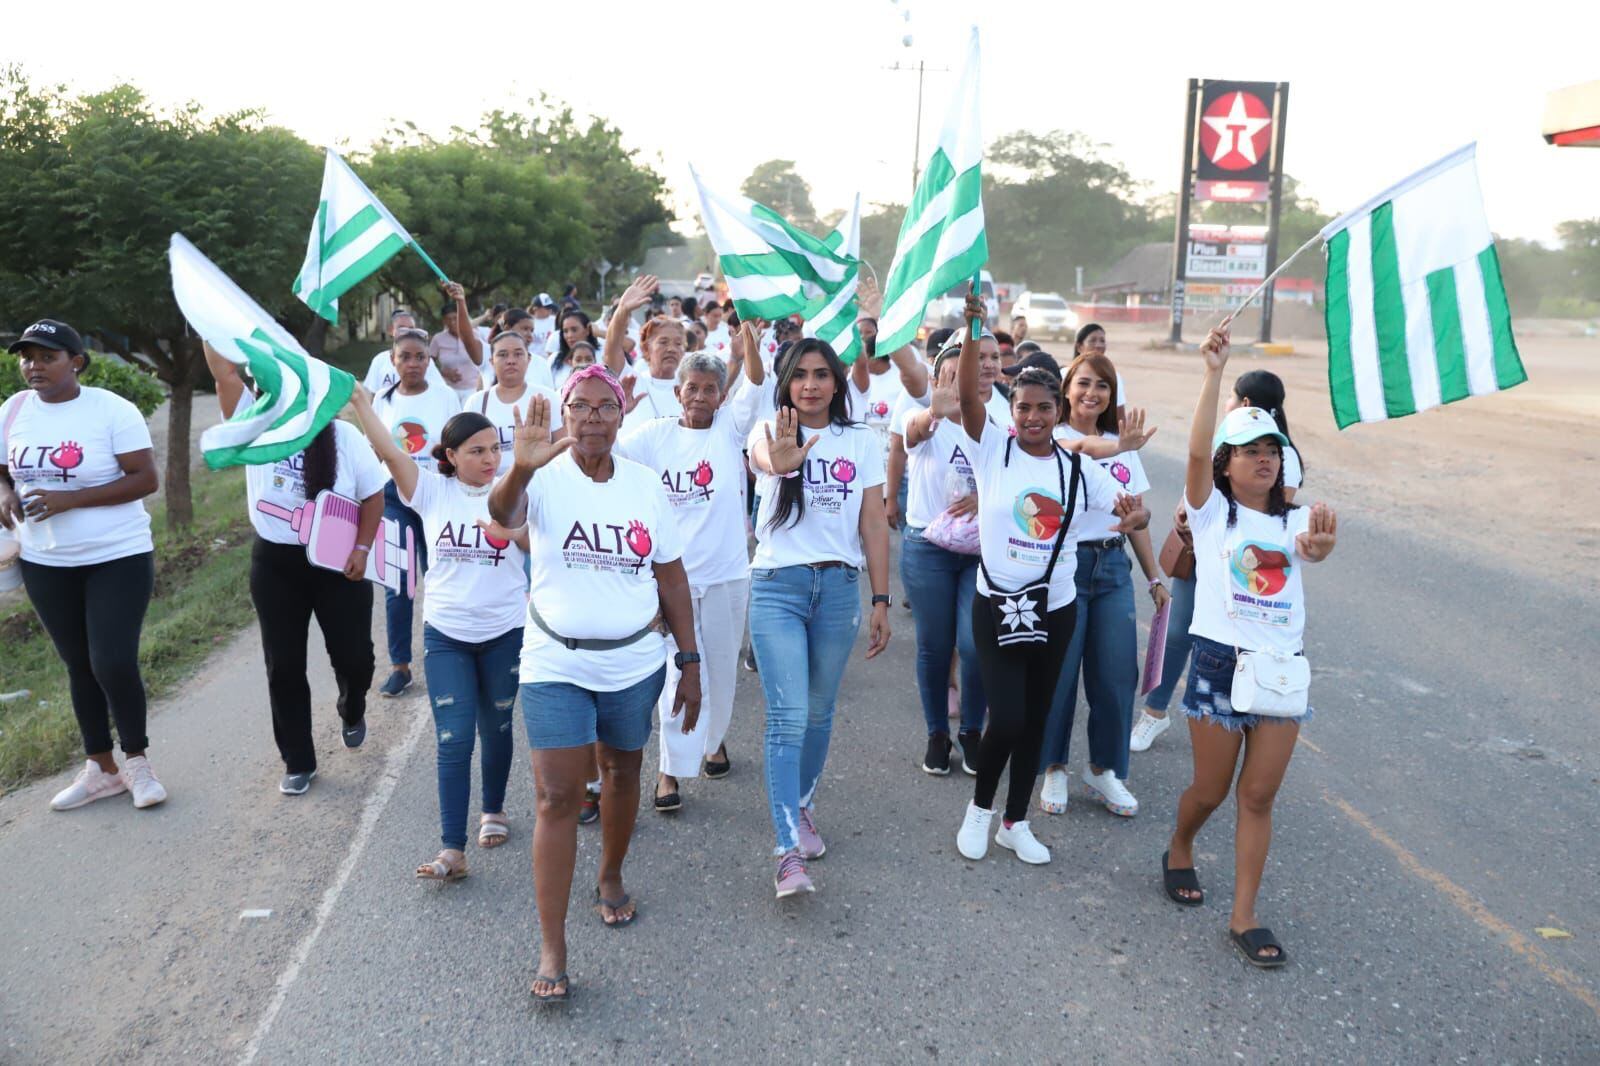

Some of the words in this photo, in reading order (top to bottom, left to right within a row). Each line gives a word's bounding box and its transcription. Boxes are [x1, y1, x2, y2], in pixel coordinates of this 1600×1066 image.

[661, 460, 714, 492] ALTO
[803, 457, 857, 485] LTO
[562, 520, 652, 558] ALTO
